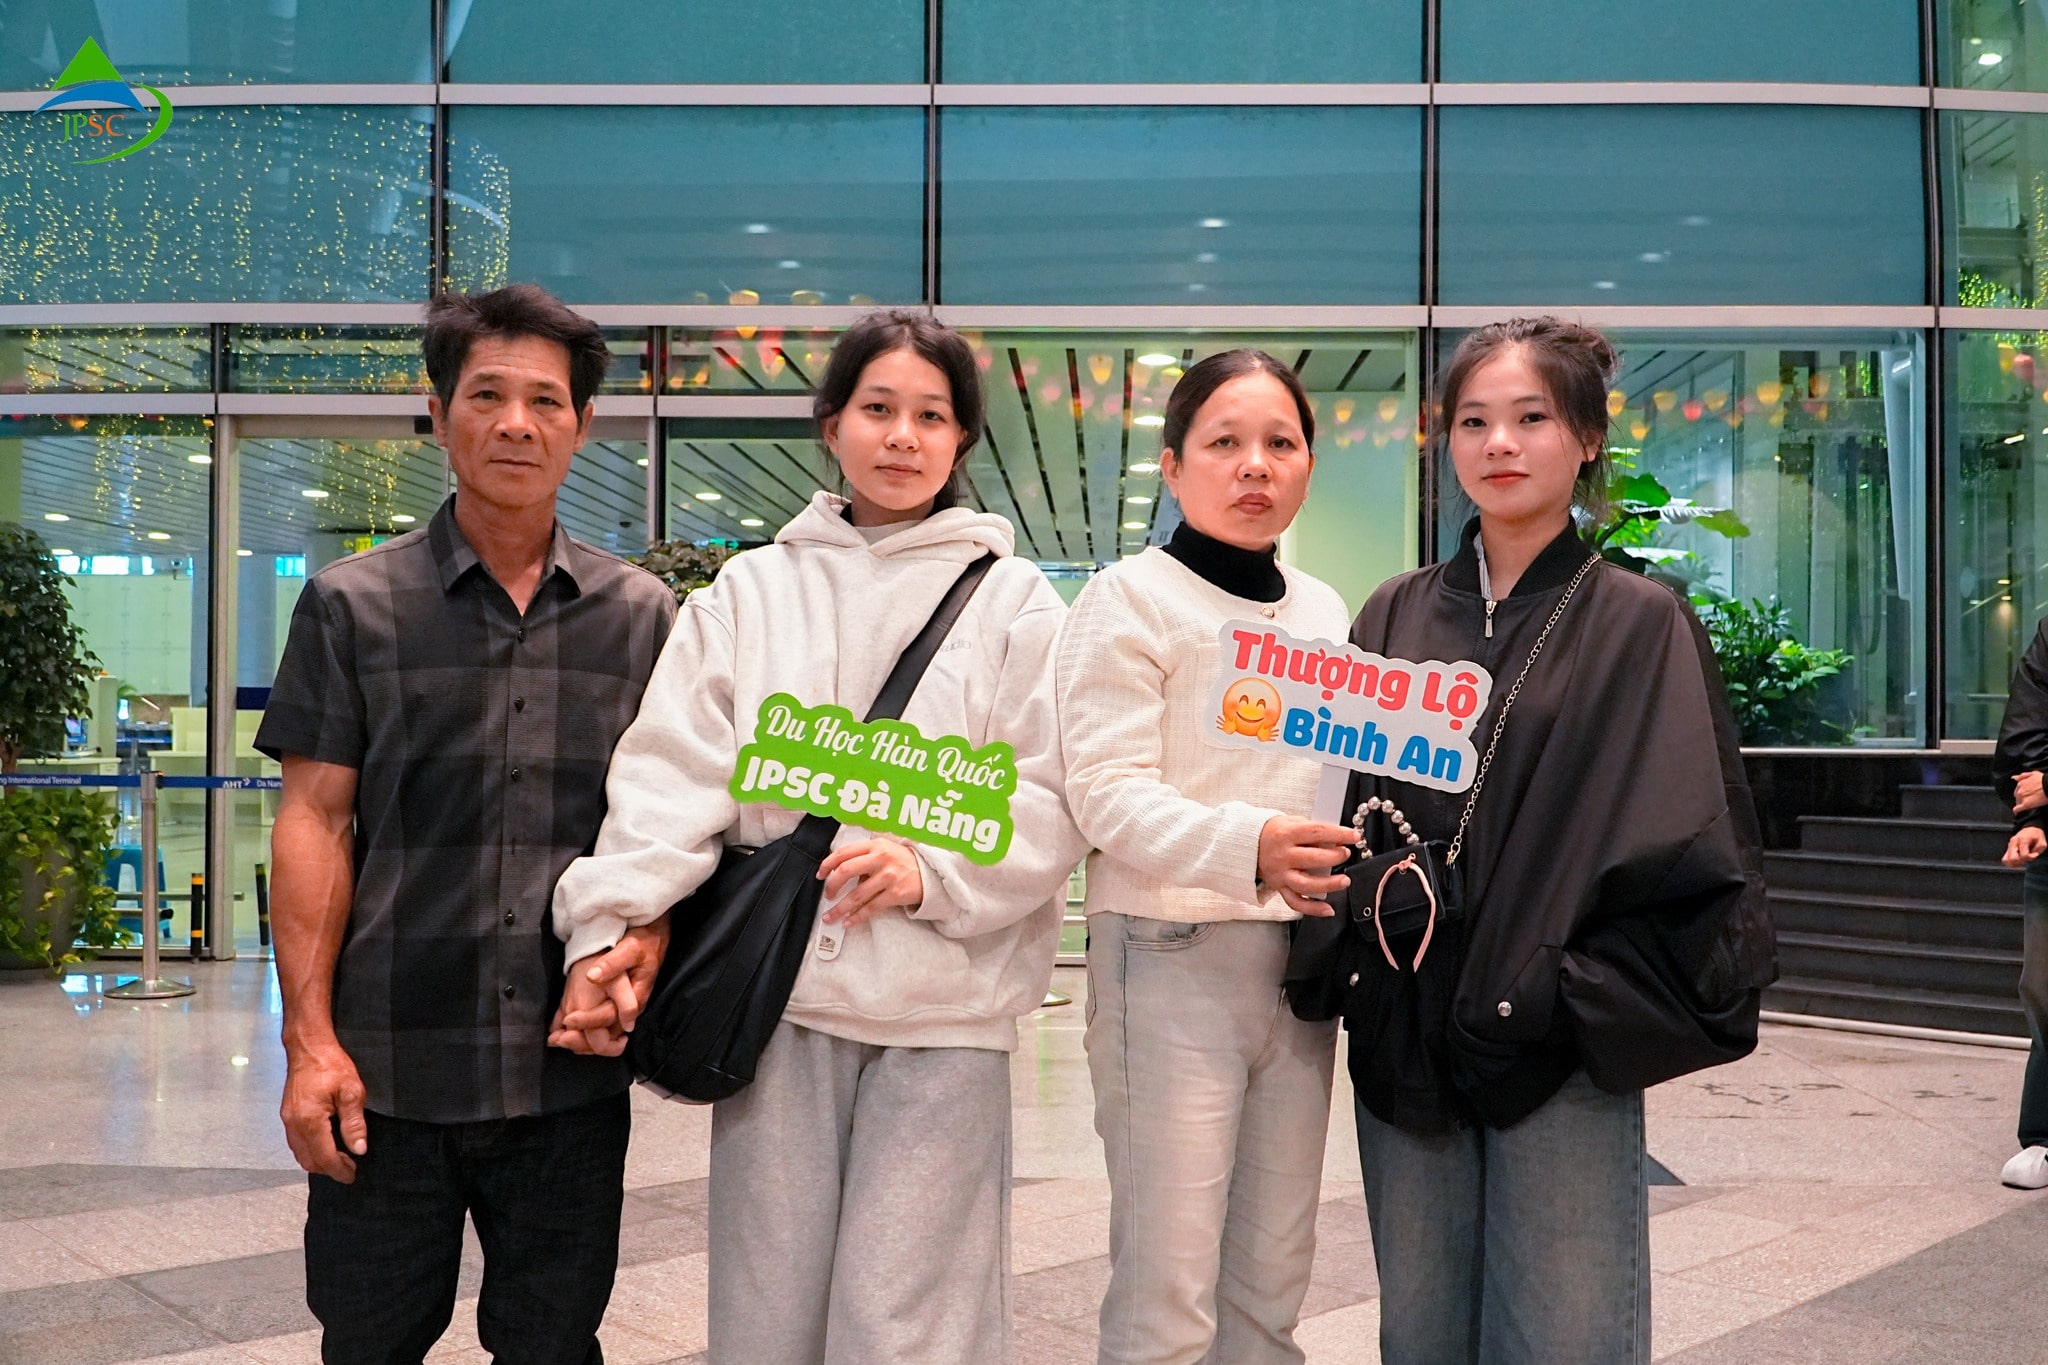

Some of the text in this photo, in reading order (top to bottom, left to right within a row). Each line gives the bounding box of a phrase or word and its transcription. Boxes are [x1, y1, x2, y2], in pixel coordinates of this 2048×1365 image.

[1232, 629, 1479, 731] Thượng Lộ
[267, 780, 283, 788] Nan
[766, 706, 1005, 790] Du Học Hàn Quốc
[1283, 706, 1462, 783] Bình An
[740, 756, 1001, 852] JPSC Đà Nẵng
